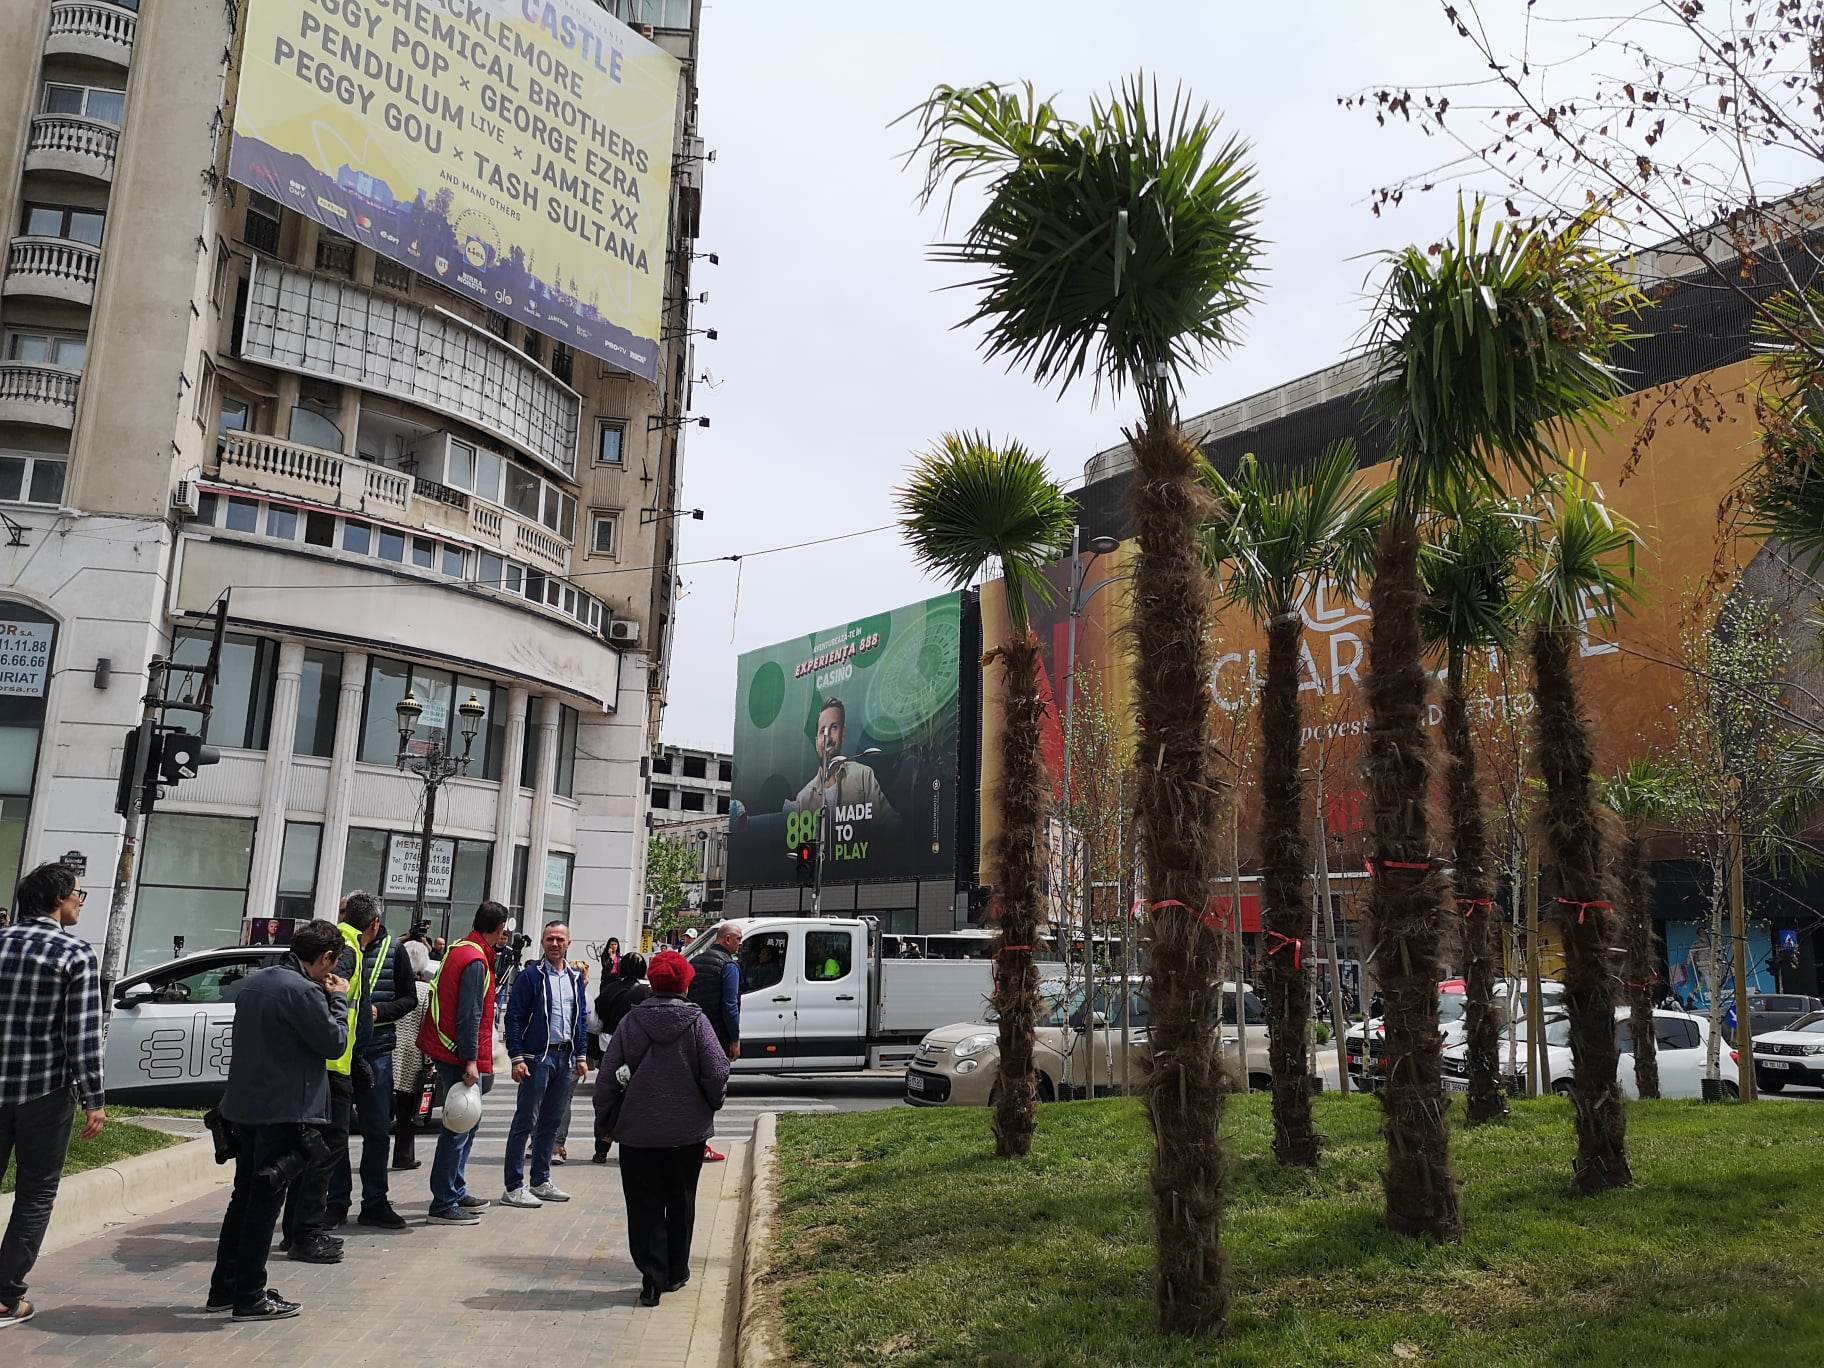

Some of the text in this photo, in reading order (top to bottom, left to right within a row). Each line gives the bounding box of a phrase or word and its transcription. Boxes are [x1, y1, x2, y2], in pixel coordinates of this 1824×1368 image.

[521, 0, 624, 84] CASTLE
[374, 0, 649, 174] HEMICAL BROTHERS
[300, 10, 639, 234] PENDULUM LIVE JAMIE XX
[391, 26, 450, 78] POP
[481, 84, 578, 164] GEORGE
[585, 148, 640, 203] EZRA
[274, 36, 649, 275] PEGGY GOU TASH SULTANA
[439, 169, 521, 222] AND MANY OTHERS
[859, 633, 880, 653] 888
[816, 664, 853, 689] CASINO
[835, 802, 873, 823] MADE
[835, 824, 854, 841] TO
[835, 842, 869, 861] PLAY
[391, 874, 403, 883] DE
